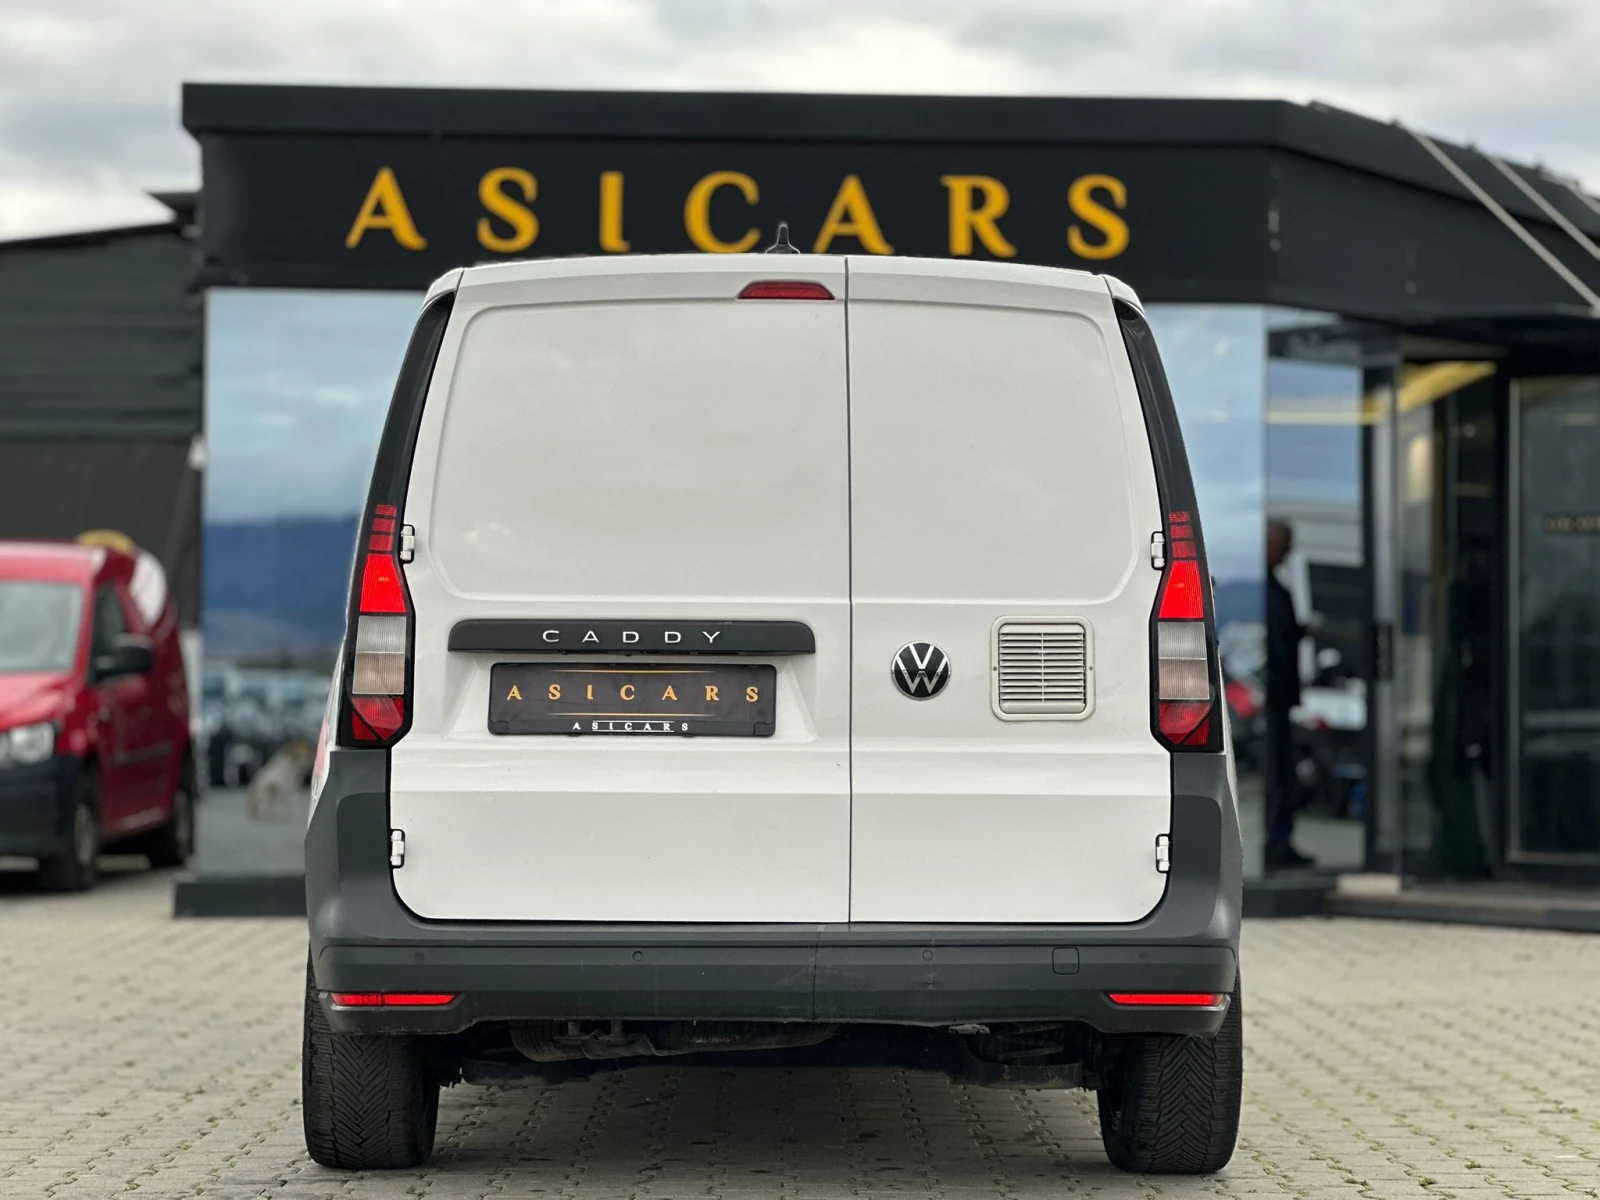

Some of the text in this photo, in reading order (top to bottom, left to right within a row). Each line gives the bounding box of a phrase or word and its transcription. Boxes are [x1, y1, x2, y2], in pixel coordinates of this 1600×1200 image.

[346, 167, 1130, 260] ASICARS
[542, 629, 721, 644] CADDY
[506, 683, 760, 702] ASICARS
[572, 721, 689, 732] ASICARS
